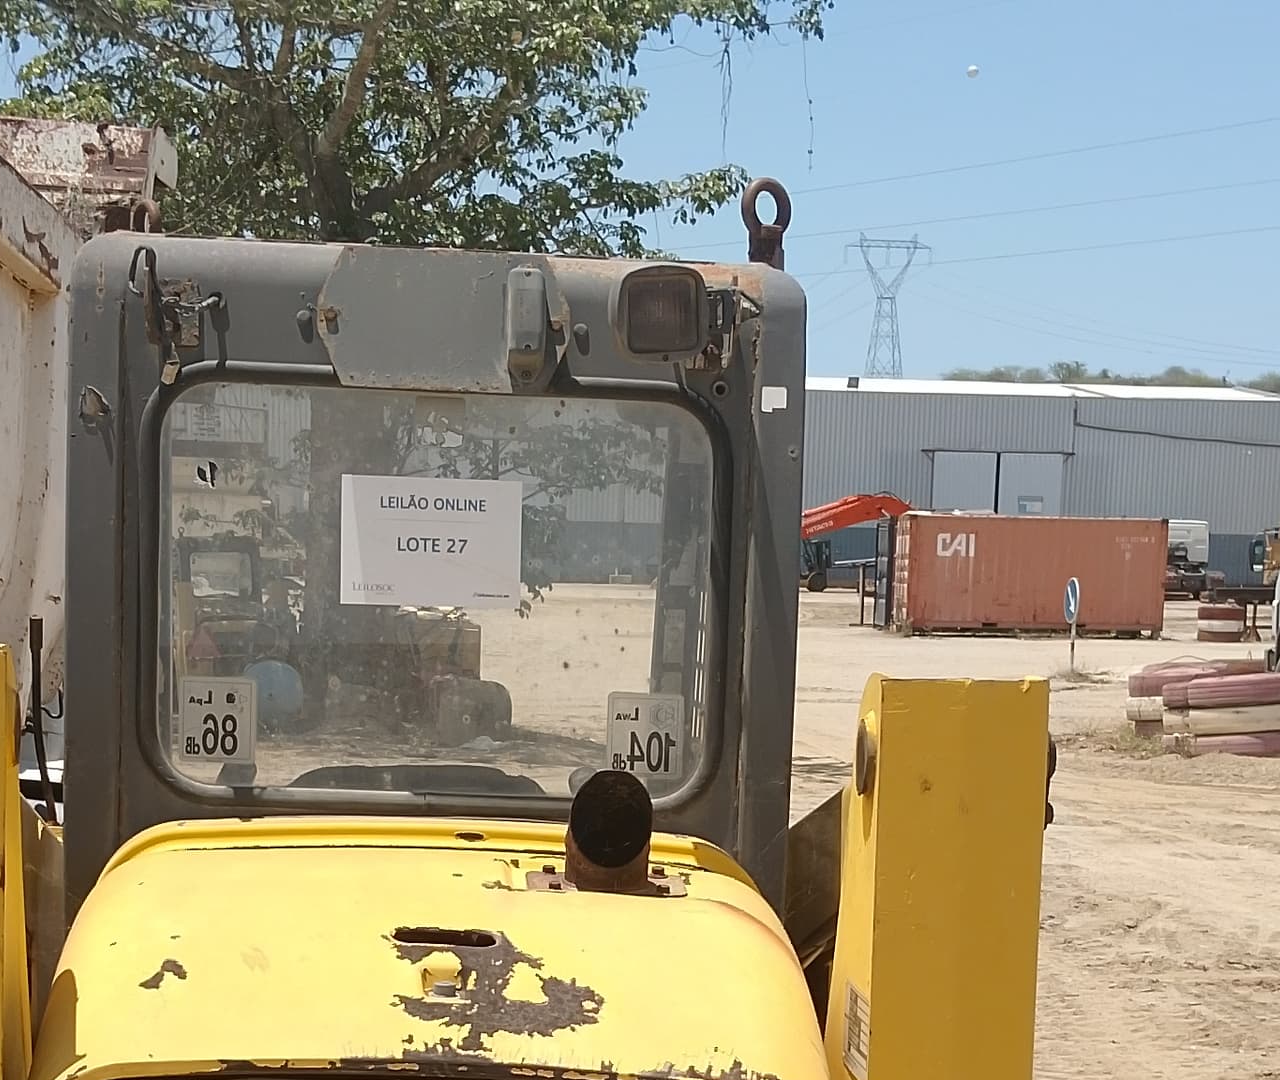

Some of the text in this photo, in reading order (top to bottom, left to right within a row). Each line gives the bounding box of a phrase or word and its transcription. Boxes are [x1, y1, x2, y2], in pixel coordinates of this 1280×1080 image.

[380, 494, 487, 512] LEILÃO ONLINE
[397, 536, 468, 554] LOTE 27
[936, 533, 976, 557] CAI
